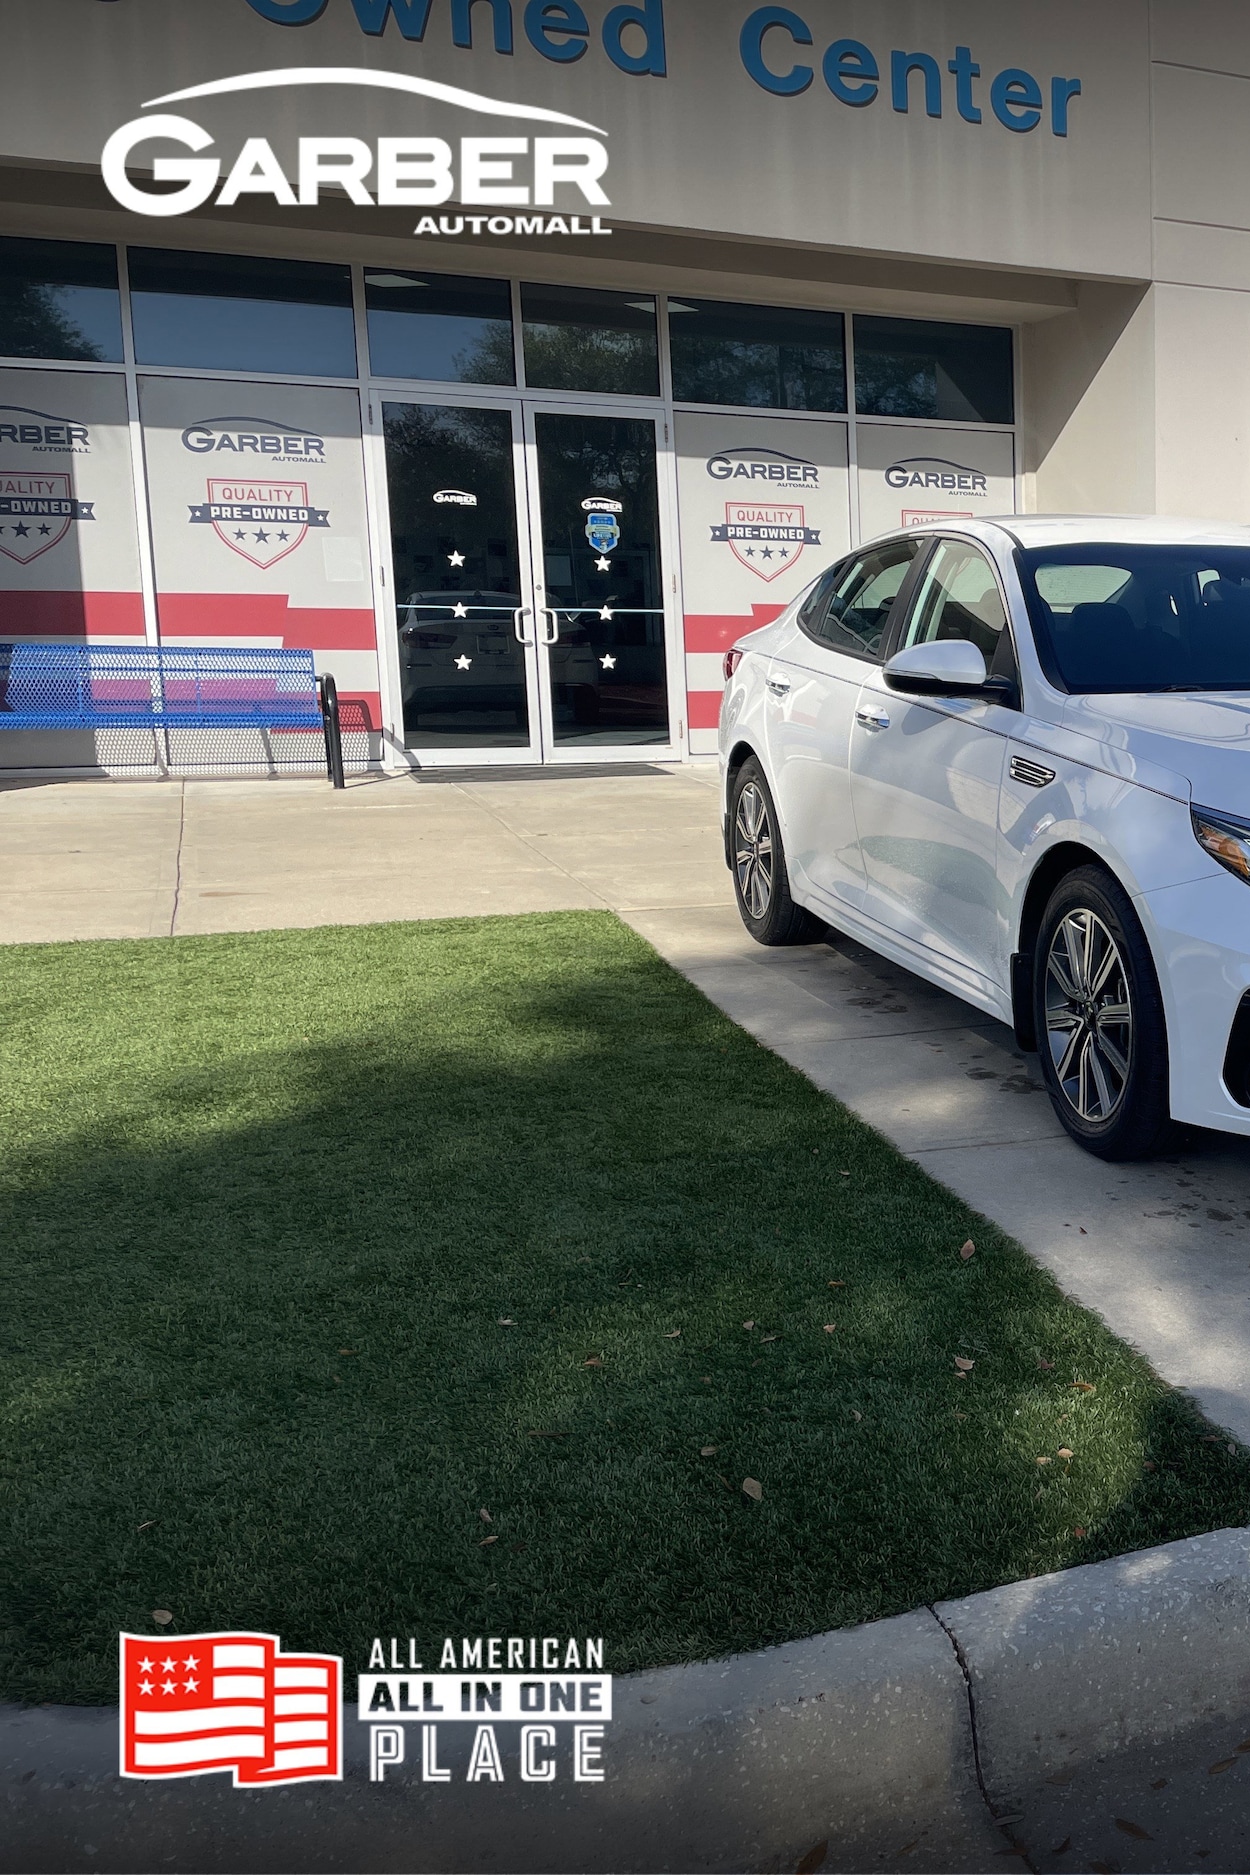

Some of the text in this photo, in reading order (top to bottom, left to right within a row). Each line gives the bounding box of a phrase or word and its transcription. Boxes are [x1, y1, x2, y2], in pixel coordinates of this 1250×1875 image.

[245, 0, 1081, 137] wned Center
[0, 424, 91, 446] RBER
[181, 426, 327, 457] GARBER
[32, 446, 92, 454] AUTOMALL
[271, 455, 327, 464] AUTOMALL
[706, 456, 820, 483] GARBER
[884, 465, 987, 491] GARBER
[0, 480, 55, 494] ALITY
[948, 490, 988, 498] AUTOMALL
[222, 487, 294, 503] QUALITY
[0, 500, 72, 514] -OWNED
[210, 506, 309, 522] PRE-OWNED
[737, 510, 793, 523] QUALITY
[727, 527, 805, 540] PRE-OWNED
